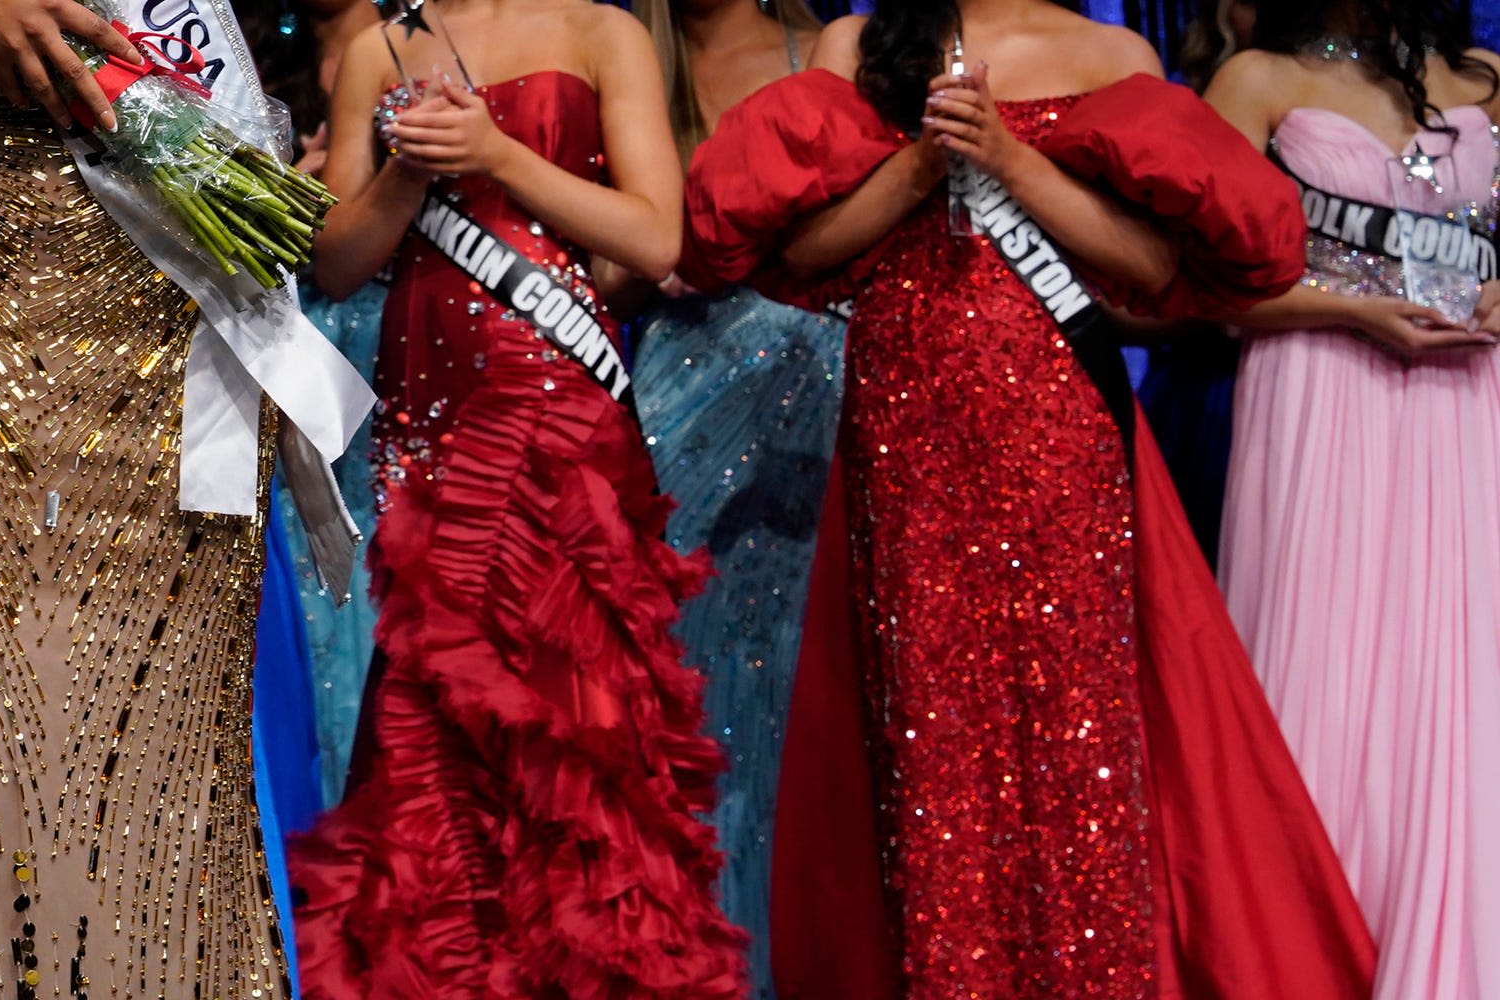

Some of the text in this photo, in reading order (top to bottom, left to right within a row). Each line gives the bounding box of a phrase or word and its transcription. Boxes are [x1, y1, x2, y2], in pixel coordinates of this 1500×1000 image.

[1297, 178, 1375, 248] OLK
[414, 196, 631, 402] NKLIN COUNTY
